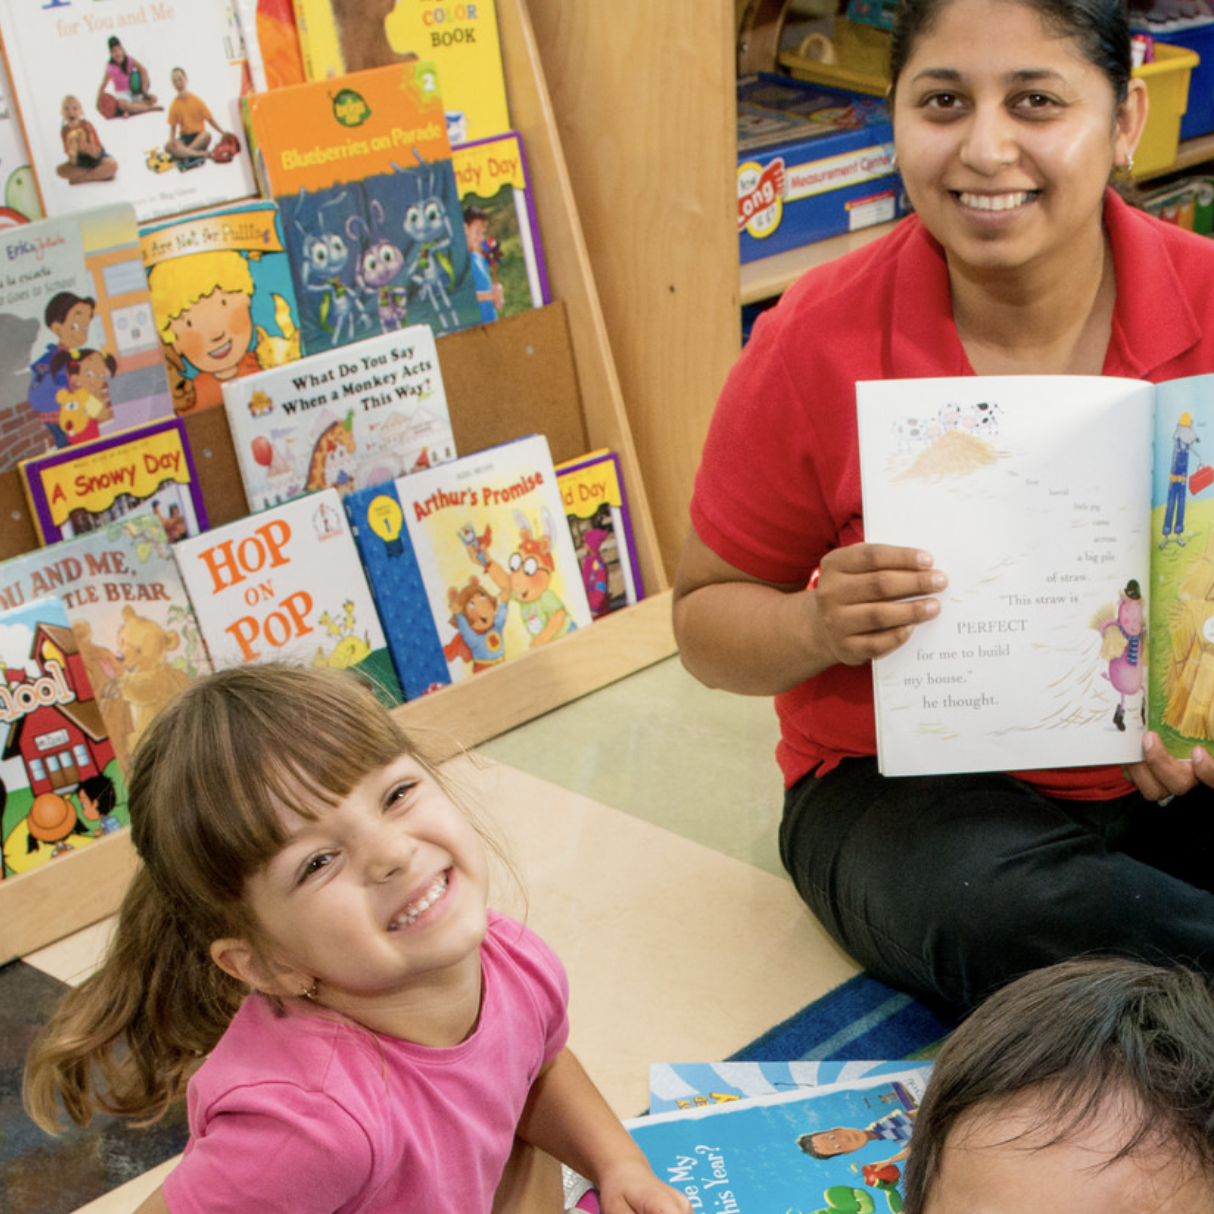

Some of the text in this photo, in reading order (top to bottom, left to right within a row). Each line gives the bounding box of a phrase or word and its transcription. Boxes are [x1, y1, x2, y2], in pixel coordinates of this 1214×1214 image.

[57, 18, 79, 37] for
[83, 13, 114, 32] You
[117, 5, 147, 27] and
[150, 2, 176, 22] Me
[422, 4, 478, 27] COLOR
[430, 28, 476, 47] BOOK
[423, 74, 436, 91] 2
[281, 122, 442, 170] Blueberries on Parade
[488, 157, 518, 179] Day
[791, 161, 858, 188] Measurement
[291, 345, 415, 391] What Do You Say
[282, 360, 432, 416] When a Monkey Acts
[360, 393, 392, 412] This
[52, 482, 67, 505] A
[74, 463, 136, 496] Snowy
[143, 450, 180, 475] Day
[413, 487, 479, 523] Arthur's
[481, 471, 545, 507] Promise
[577, 481, 607, 502] Day
[197, 519, 291, 595] HOP
[1085, 551, 1099, 564] big
[1100, 552, 1115, 564] pile
[30, 557, 83, 598] AND
[84, 550, 137, 578] ME,
[1046, 573, 1092, 583] of straw.
[103, 582, 172, 602] BEAR
[244, 578, 275, 607] ON
[1000, 594, 1079, 607] "This straw is
[224, 590, 314, 665] POP
[956, 619, 1028, 634] PERFECT
[916, 644, 1010, 662] for me to build
[904, 675, 923, 689] my
[923, 693, 999, 711] he thought.
[667, 1155, 698, 1183] My
[694, 1144, 730, 1190] Year?
